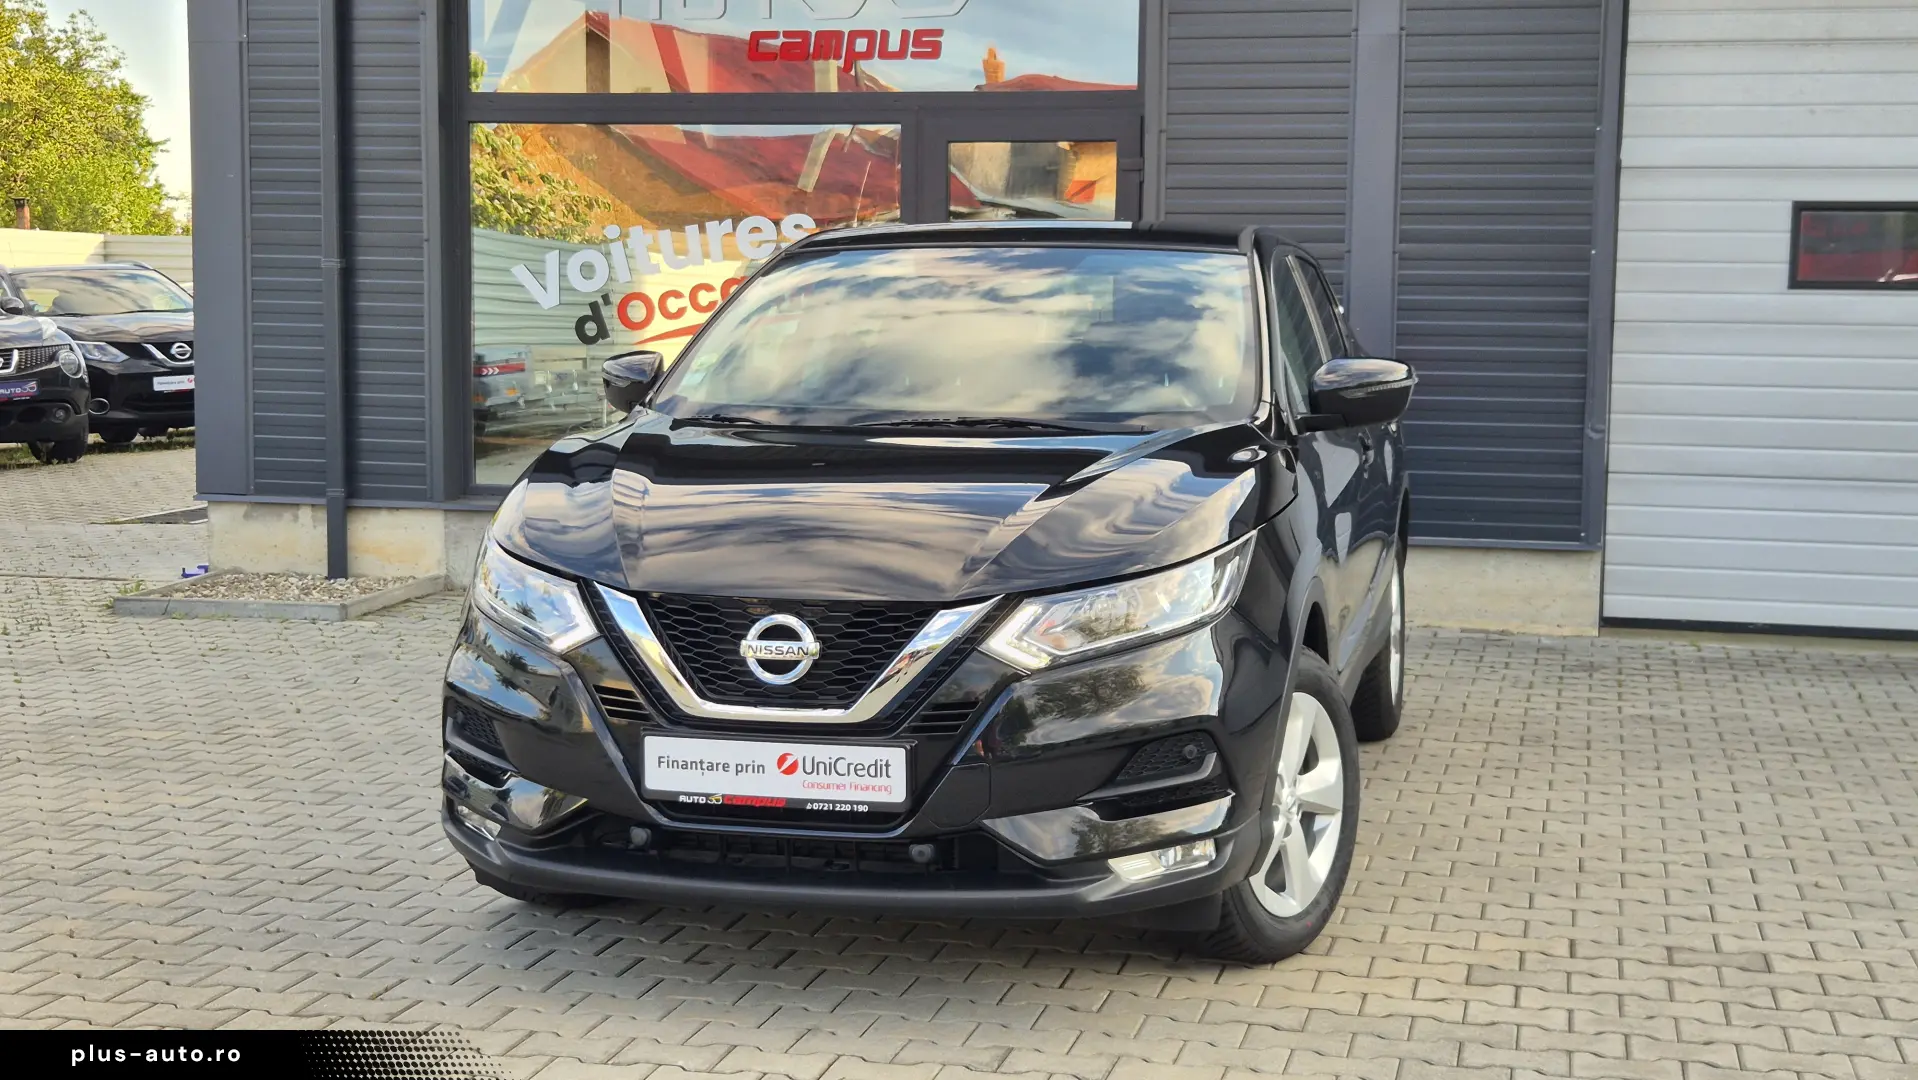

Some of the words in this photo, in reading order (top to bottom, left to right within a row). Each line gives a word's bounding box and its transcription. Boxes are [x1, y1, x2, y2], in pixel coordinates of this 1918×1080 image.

[747, 28, 944, 73] campus
[510, 213, 817, 310] Voitures
[747, 645, 809, 656] NISSAN
[657, 755, 730, 776] Finanțare
[735, 761, 766, 776] prin
[802, 756, 892, 778] UniCredit
[802, 780, 847, 791] Consumer
[849, 782, 892, 795] Financing
[679, 794, 706, 804] AUTO
[812, 803, 833, 811] 0721
[834, 803, 851, 812] 220
[852, 804, 869, 812] 190
